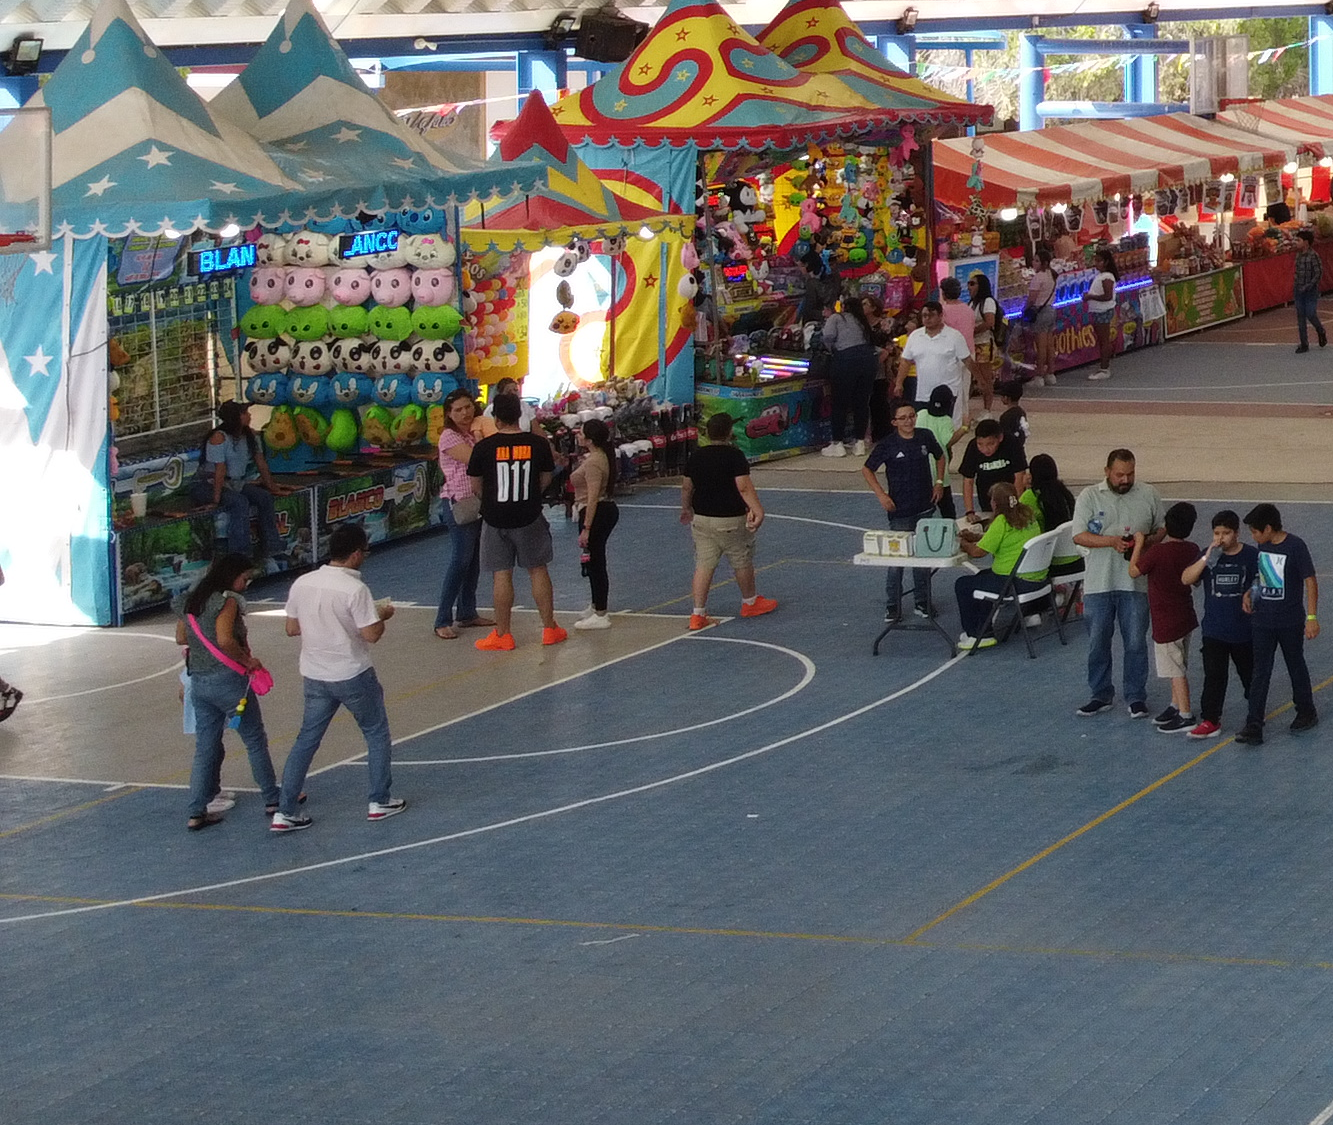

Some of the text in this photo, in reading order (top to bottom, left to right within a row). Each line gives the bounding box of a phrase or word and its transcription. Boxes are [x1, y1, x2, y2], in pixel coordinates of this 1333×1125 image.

[199, 245, 254, 273] BLAN
[496, 460, 531, 503] D11
[326, 484, 385, 524] BLANCO
